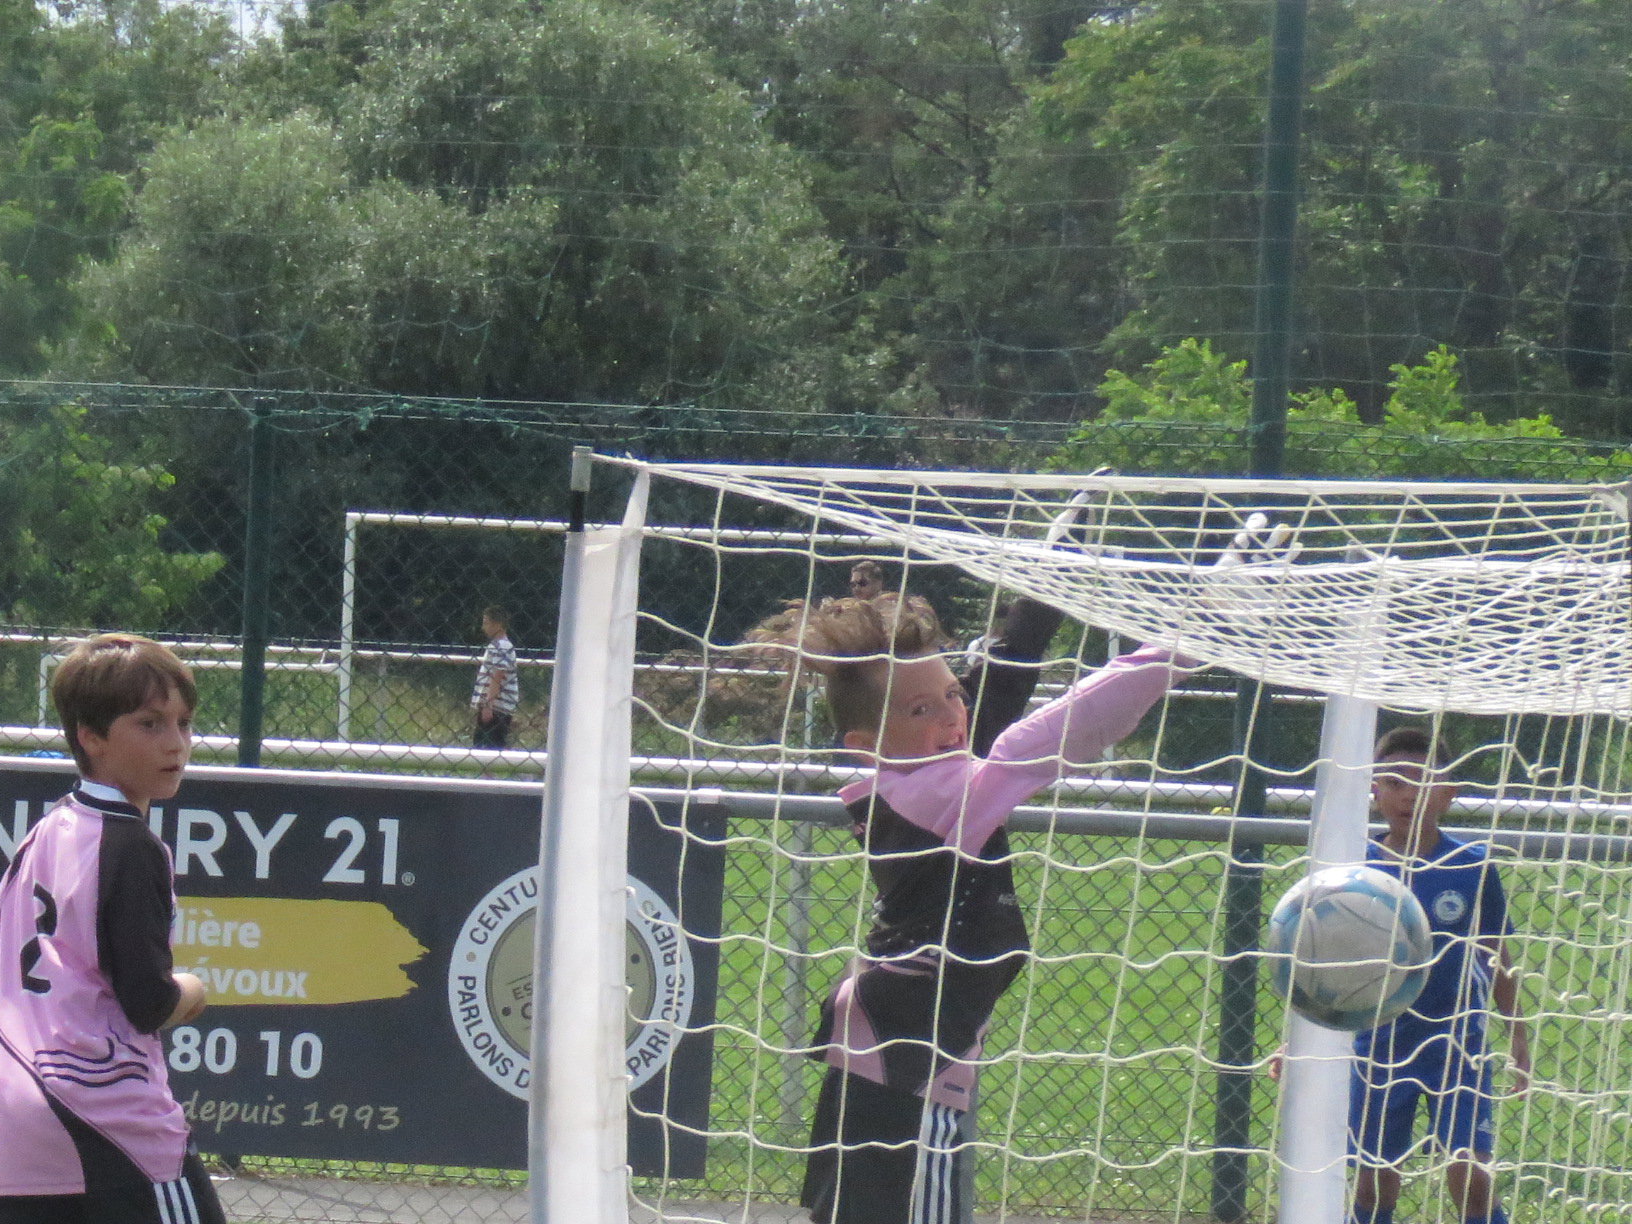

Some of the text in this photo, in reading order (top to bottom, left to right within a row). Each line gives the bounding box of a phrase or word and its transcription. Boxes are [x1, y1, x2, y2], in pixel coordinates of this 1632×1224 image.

[322, 816, 399, 885] 21
[470, 877, 538, 946] CENTU
[169, 1026, 237, 1074] 80
[260, 1030, 323, 1079] 10
[458, 974, 514, 1077] PARLONS
[183, 1090, 286, 1133] depuis
[301, 1101, 401, 1131] 1993
